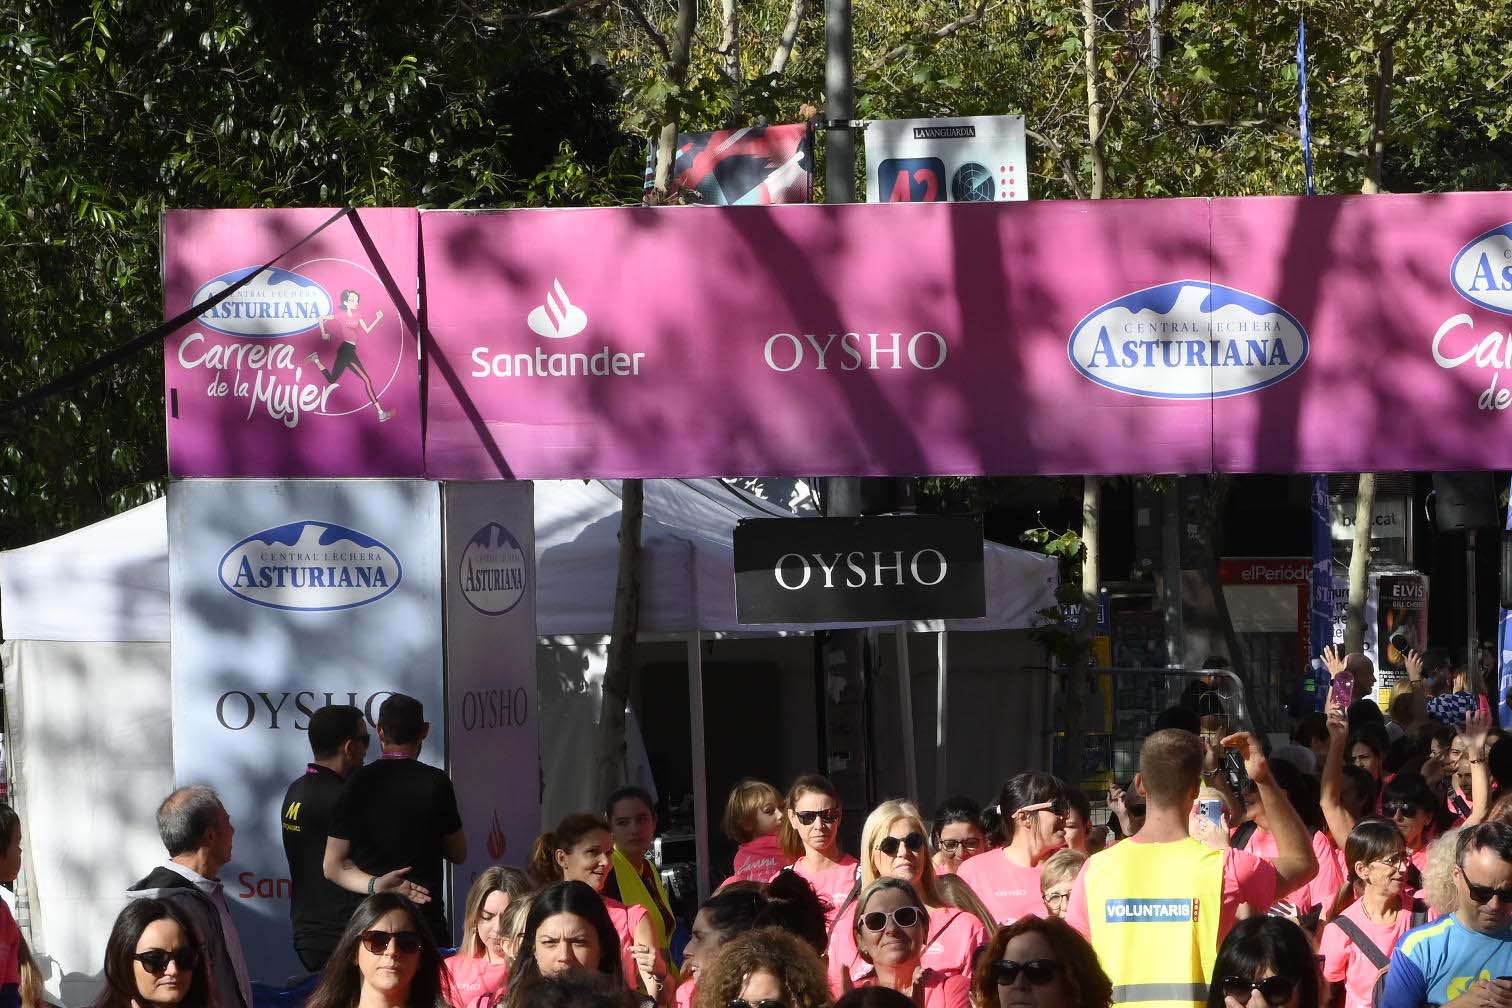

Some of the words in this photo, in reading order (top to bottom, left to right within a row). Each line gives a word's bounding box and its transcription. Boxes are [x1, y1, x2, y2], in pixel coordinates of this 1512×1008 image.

[915, 129, 926, 138] LA
[926, 127, 975, 138] VANGUARDIA
[201, 291, 321, 319] ASTURIANA
[1124, 320, 1202, 334] CENTRAL
[1209, 319, 1282, 332] LECHERA
[178, 332, 295, 370] Carrera
[472, 345, 645, 378] Santander
[764, 331, 948, 371] OYSHO
[1087, 324, 1291, 368] ASTURIANA
[207, 372, 229, 397] de
[234, 370, 249, 397] la
[246, 366, 340, 429] Mujer
[1478, 372, 1512, 410] de
[233, 555, 389, 588] ASTURIANA
[261, 553, 319, 561] CENTRAL
[324, 553, 382, 561] LECHERA
[774, 547, 949, 591] OYSHO
[465, 558, 523, 593] ASTURIANA
[1392, 585, 1424, 598] ELVIS
[462, 687, 529, 731] OYSHO
[1106, 904, 1190, 917] VOLUNTARIS
